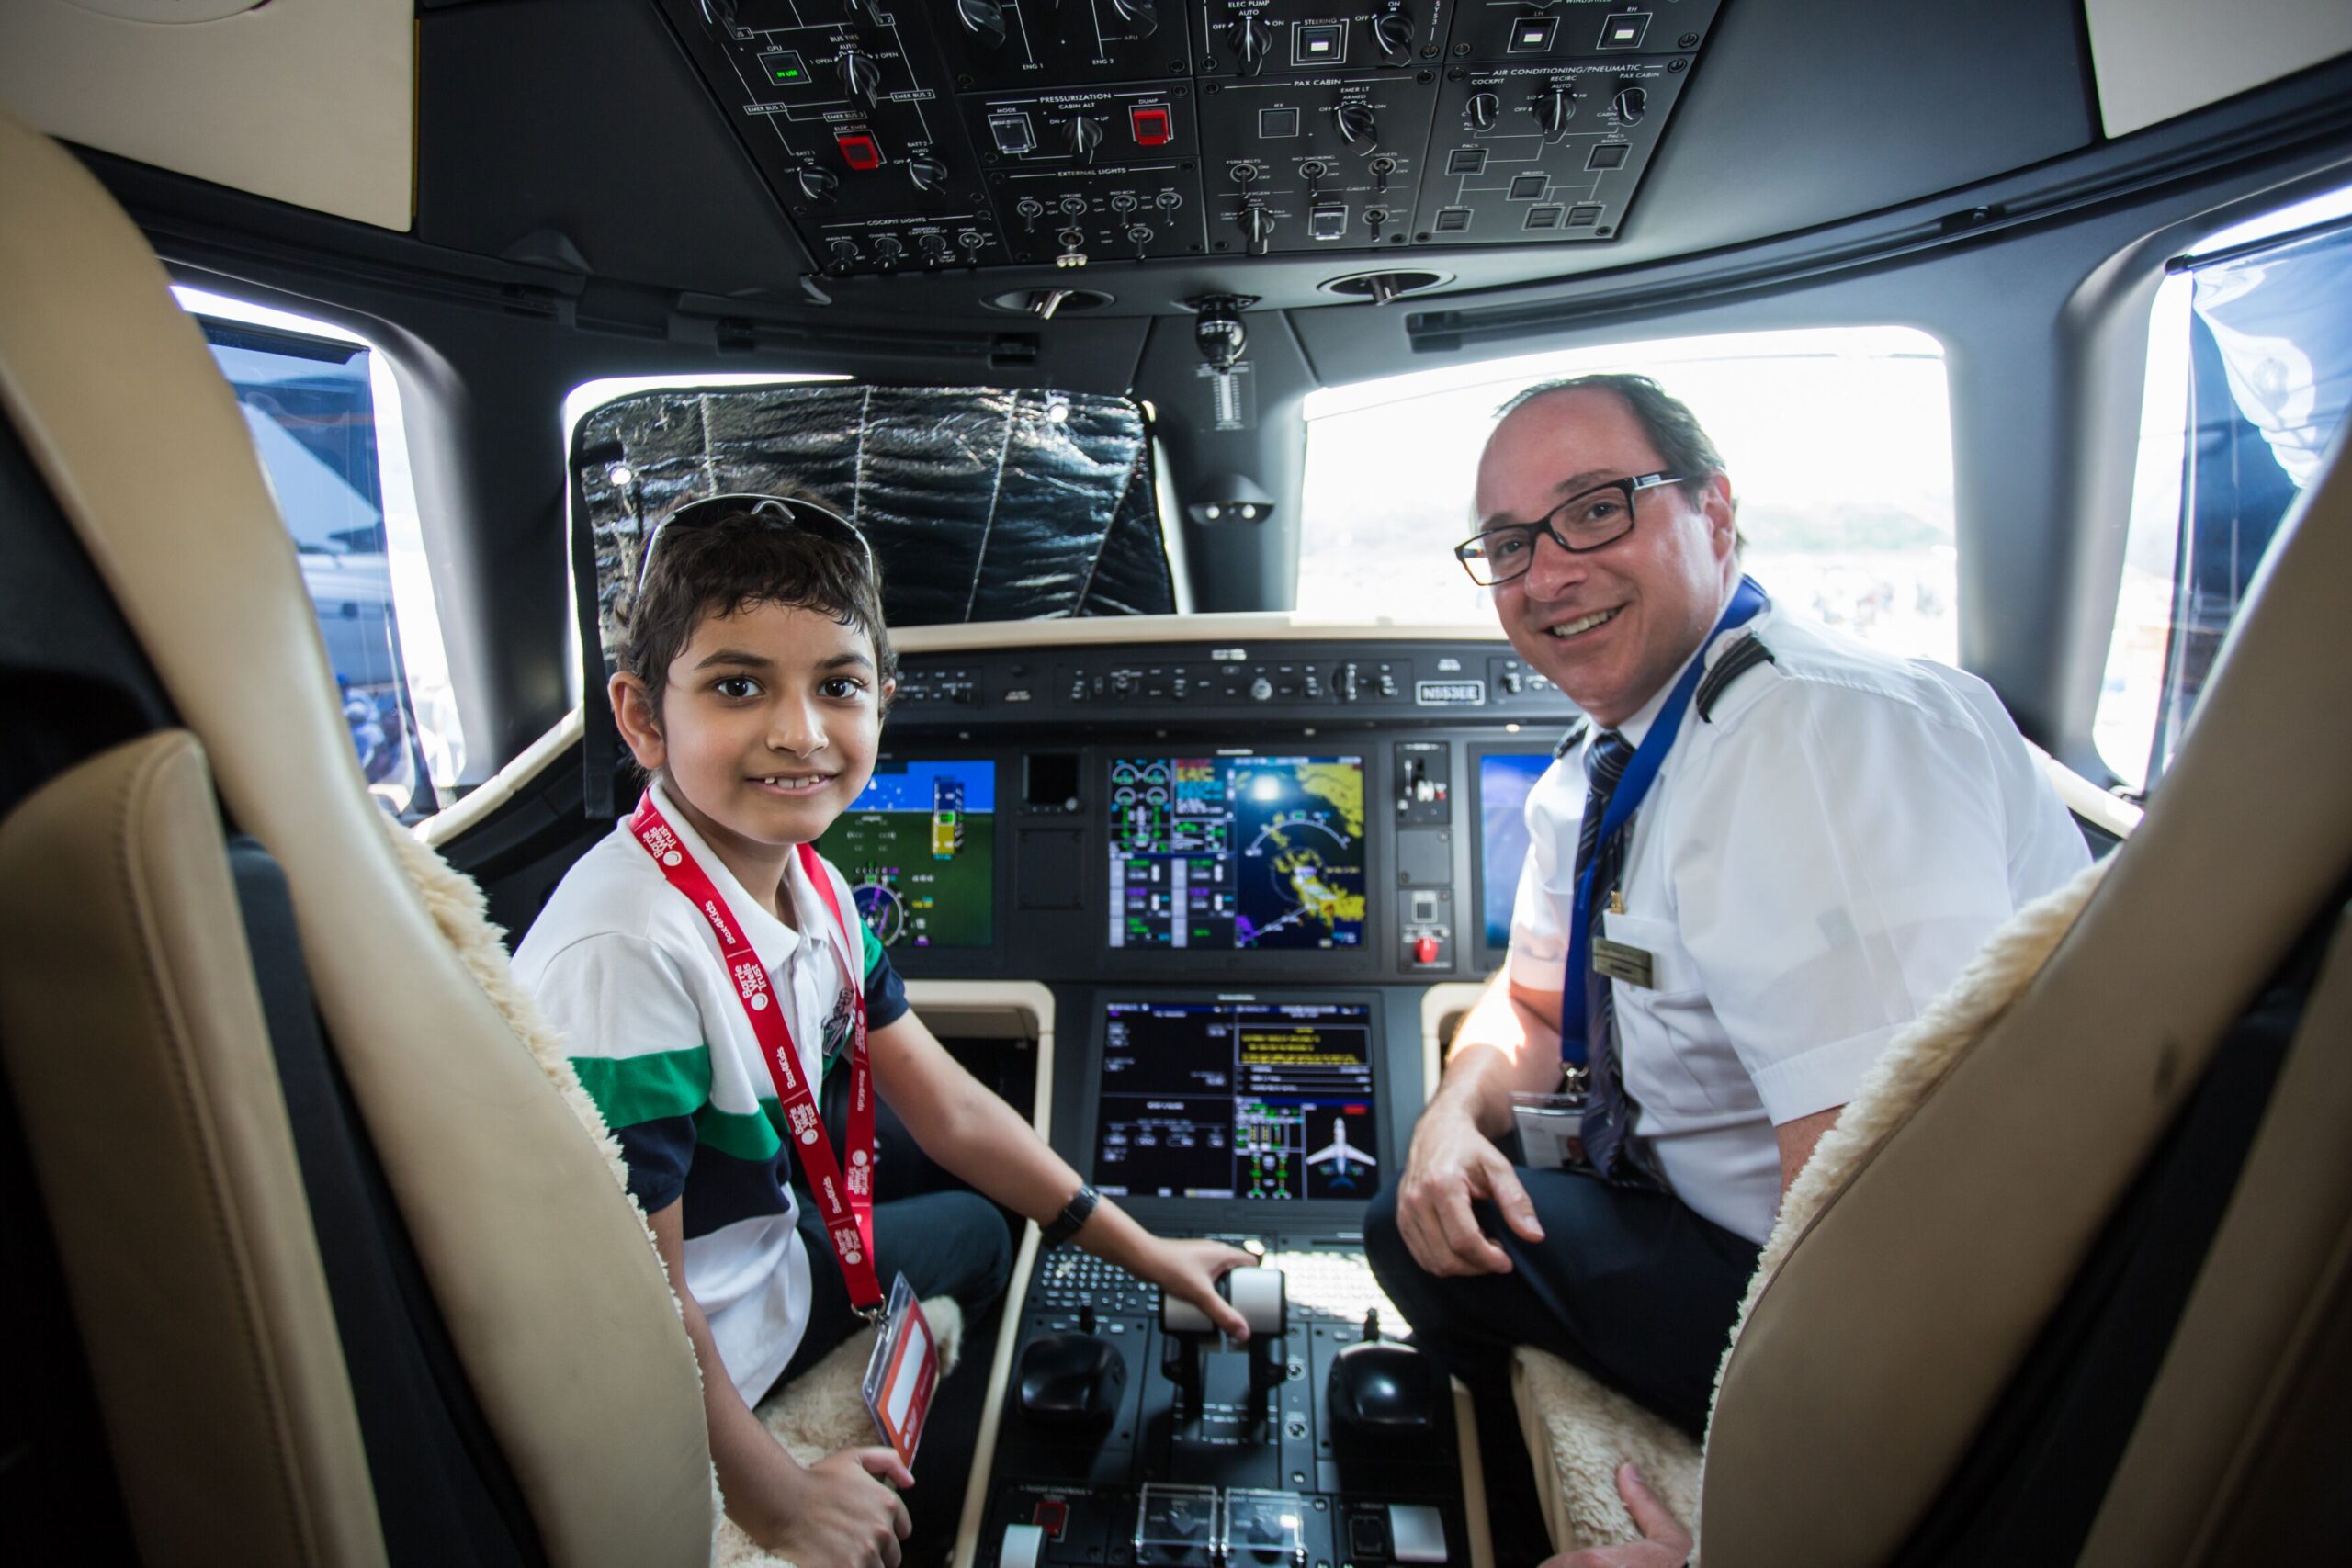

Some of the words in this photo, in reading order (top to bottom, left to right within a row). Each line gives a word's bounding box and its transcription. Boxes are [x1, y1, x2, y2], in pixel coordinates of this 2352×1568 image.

[785, 69, 800, 77] USE
[1312, 78, 1341, 86] CABIN
[1510, 63, 1641, 75] CONDITIONING/PNEUMATIC
[1039, 93, 1112, 103] PRESSURIZATION
[1057, 169, 1097, 177] EXTERNAL
[642, 831, 664, 859] Barrie
[650, 826, 669, 852] Wells
[658, 824, 677, 850] Trust
[705, 900, 737, 945] Box4Kids
[735, 964, 752, 999] Barrie
[742, 962, 759, 993] Wells
[752, 963, 768, 991] Trust
[776, 1045, 797, 1089] Box4Kids
[789, 1106, 804, 1136] Barrie
[797, 1103, 810, 1130] Wells
[804, 1102, 819, 1128] Trust
